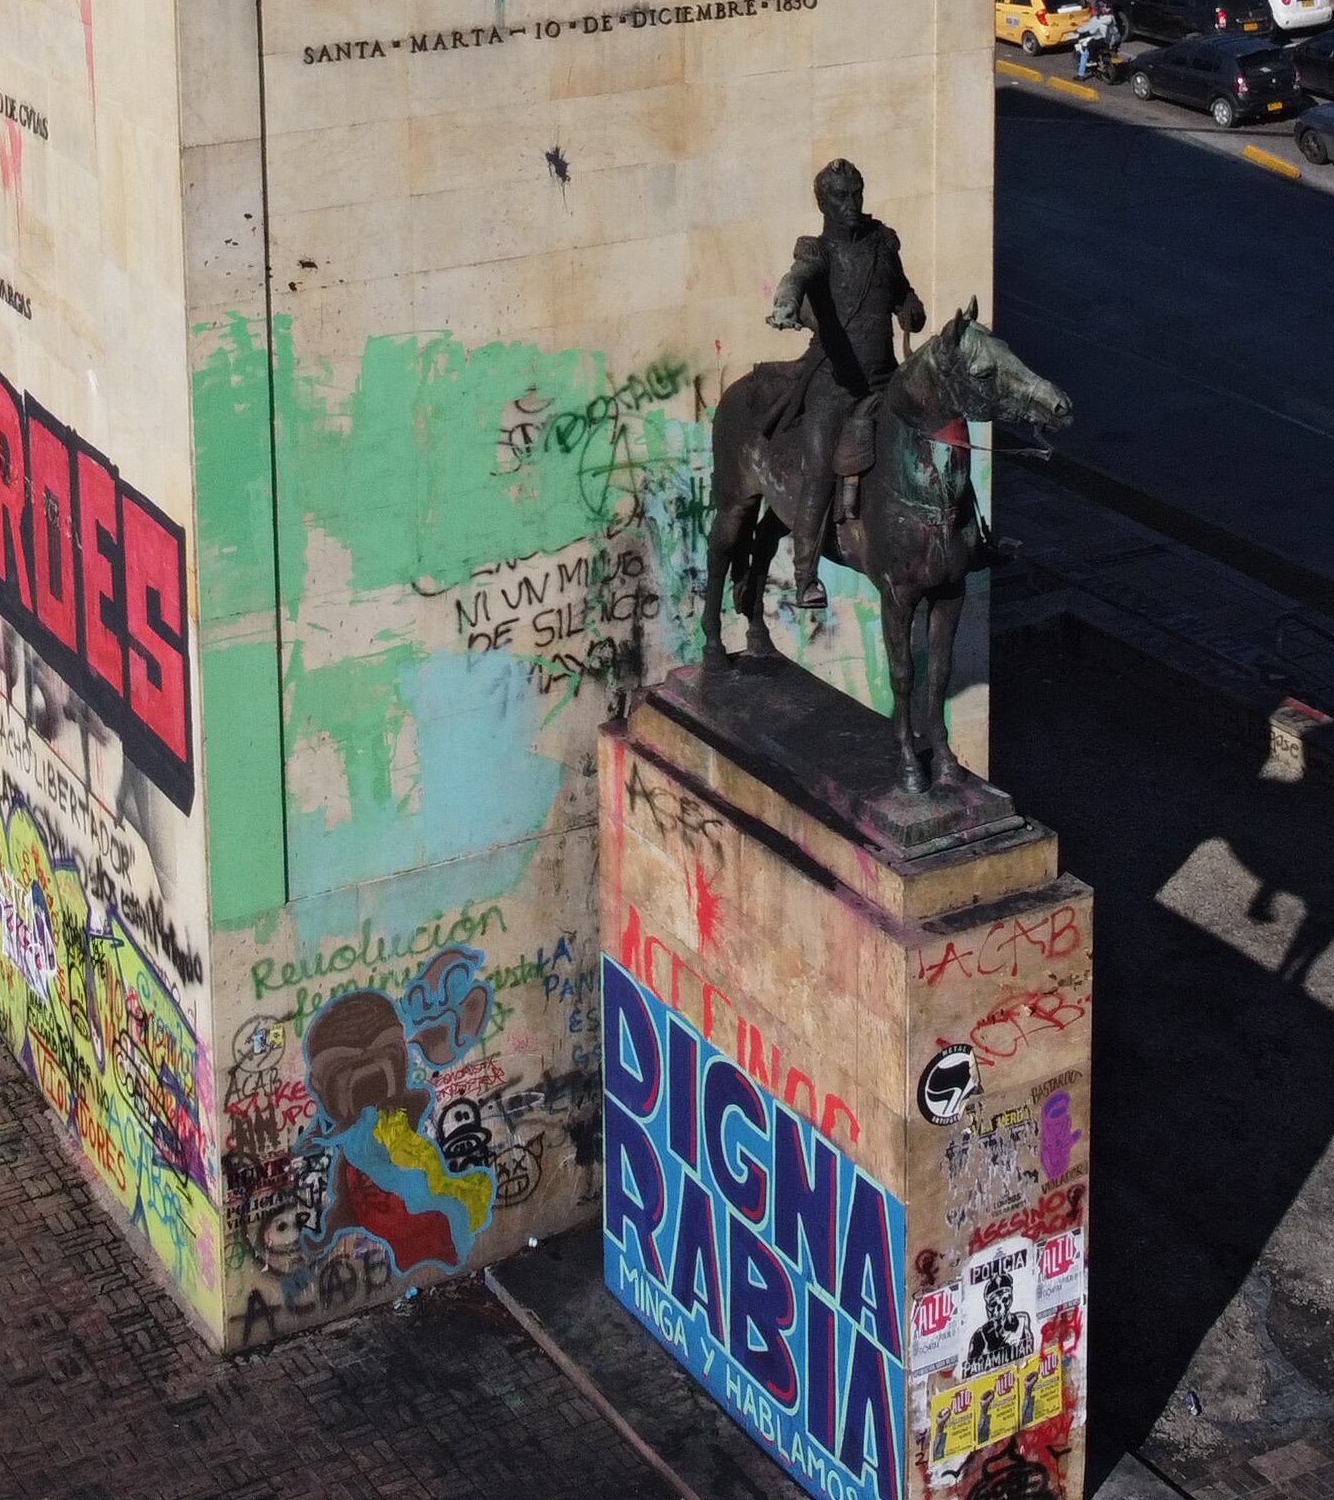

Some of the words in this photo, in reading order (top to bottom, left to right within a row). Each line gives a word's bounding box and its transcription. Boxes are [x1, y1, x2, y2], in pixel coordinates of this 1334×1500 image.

[303, 40, 386, 65] SANTA
[583, 14, 613, 36] DE
[631, 0, 757, 29] DICIEMBRE
[501, 572, 550, 610] UN
[603, 952, 903, 1369] DIGNA
[970, 1250, 1027, 1284] POLICIA
[1042, 1237, 1074, 1273] ALTO
[603, 1103, 903, 1500] RABIA
[619, 1253, 690, 1363] MINGA
[700, 1337, 715, 1381] Y
[919, 1291, 953, 1332] ALTO
[995, 1371, 1014, 1394] ALTO
[1039, 1354, 1057, 1376] ALTO
[952, 1390, 971, 1412] ALTO
